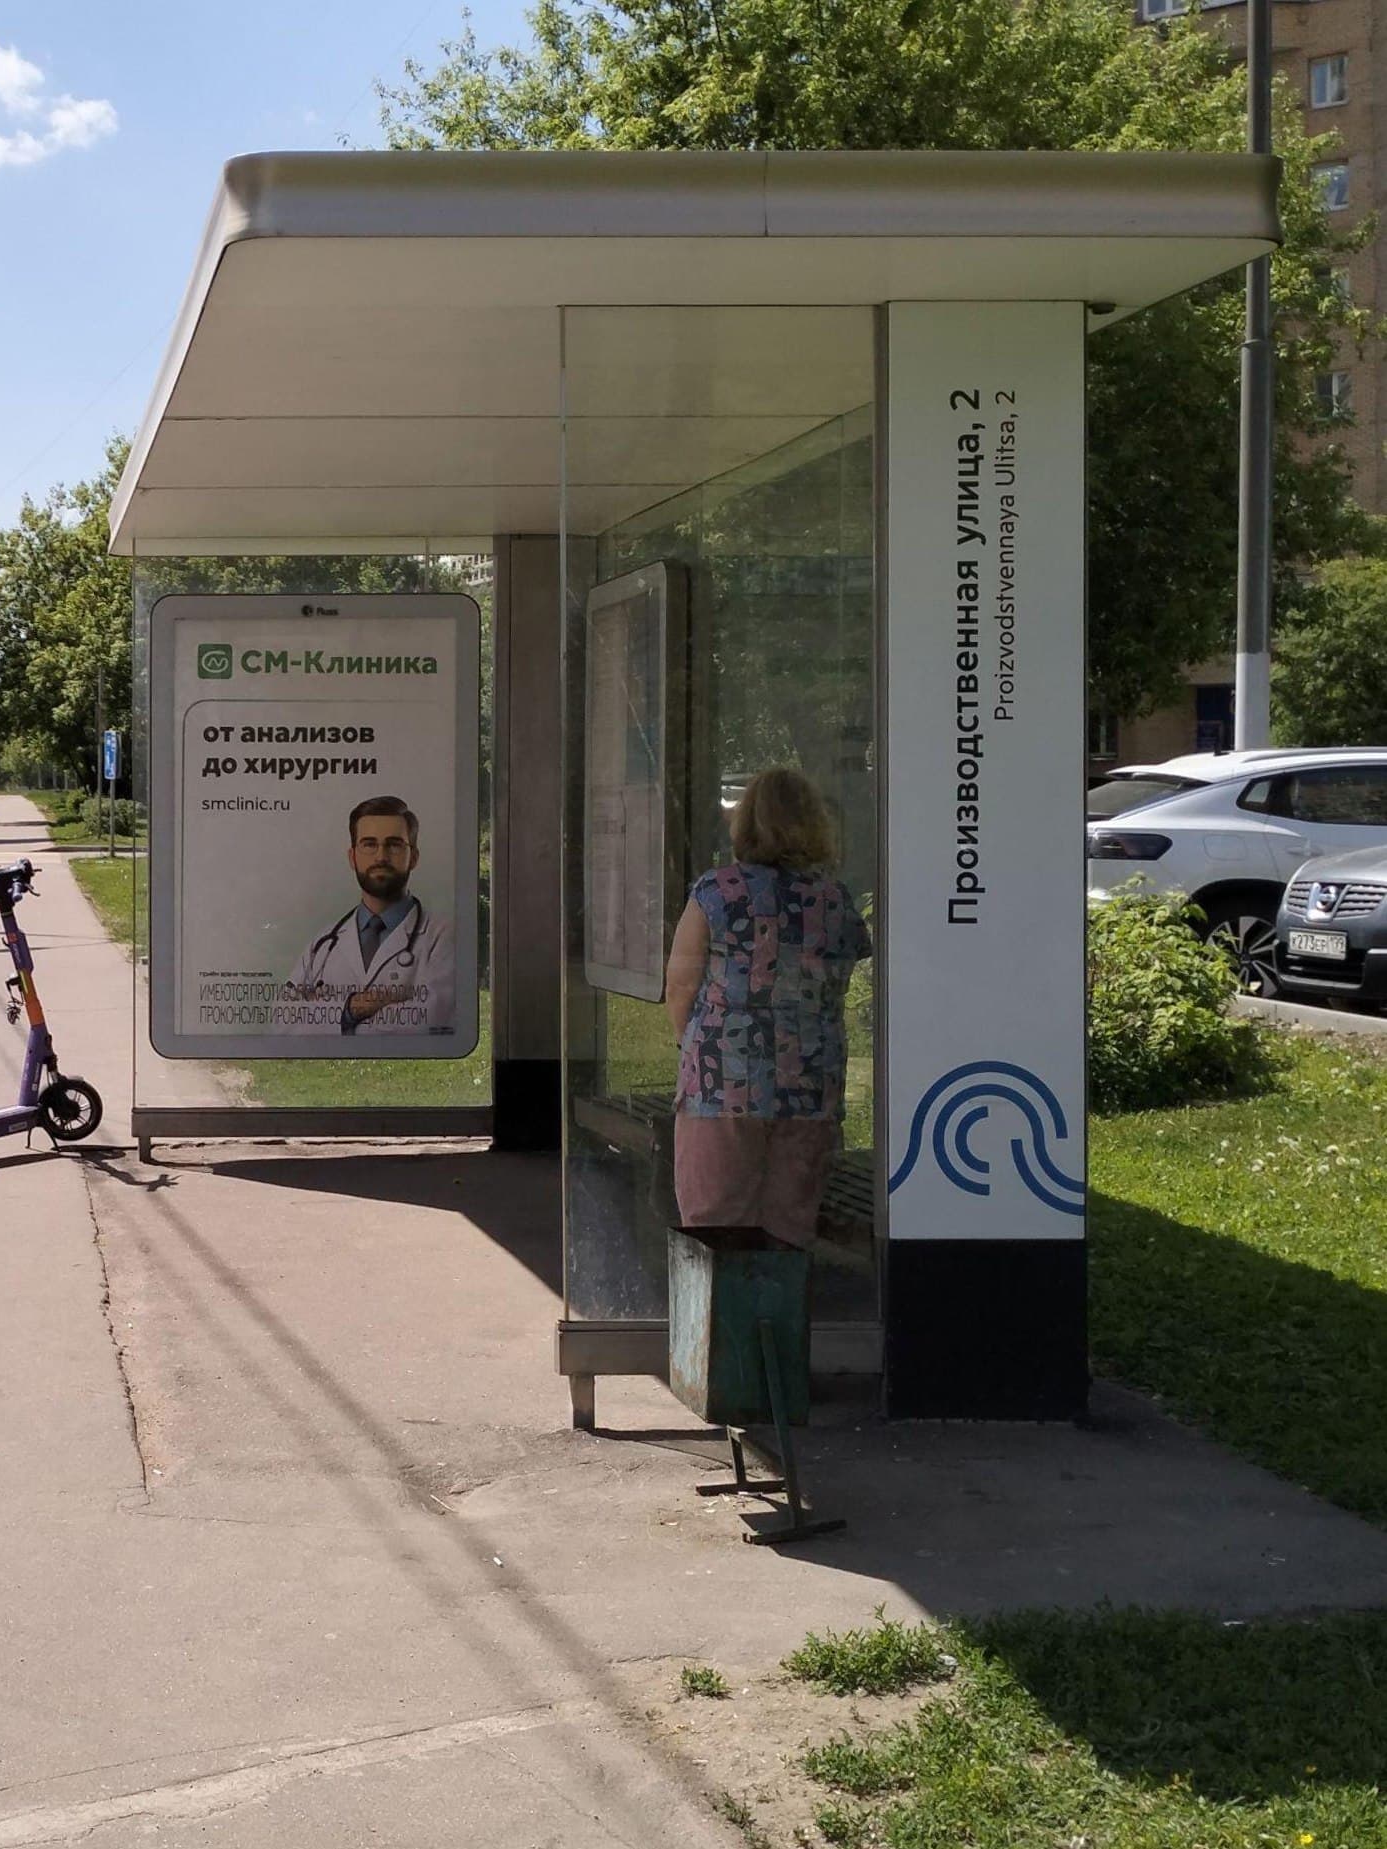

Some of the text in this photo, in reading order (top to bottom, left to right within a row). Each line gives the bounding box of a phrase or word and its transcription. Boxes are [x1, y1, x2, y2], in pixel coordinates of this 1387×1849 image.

[994, 390, 1019, 721] Proizvodstvennaya Ulitsa, 2
[240, 649, 438, 675] СМ-Клиника
[948, 388, 986, 925] Производственная улица, 2
[203, 725, 375, 744] от анализов
[201, 756, 378, 780] до хирургии
[201, 796, 291, 811] smclinic.ru
[199, 983, 249, 1002] ИМЕЮТСЯ
[199, 1006, 327, 1025] ПРОКОНСУЛЬТИРОВАТЬСЯ
